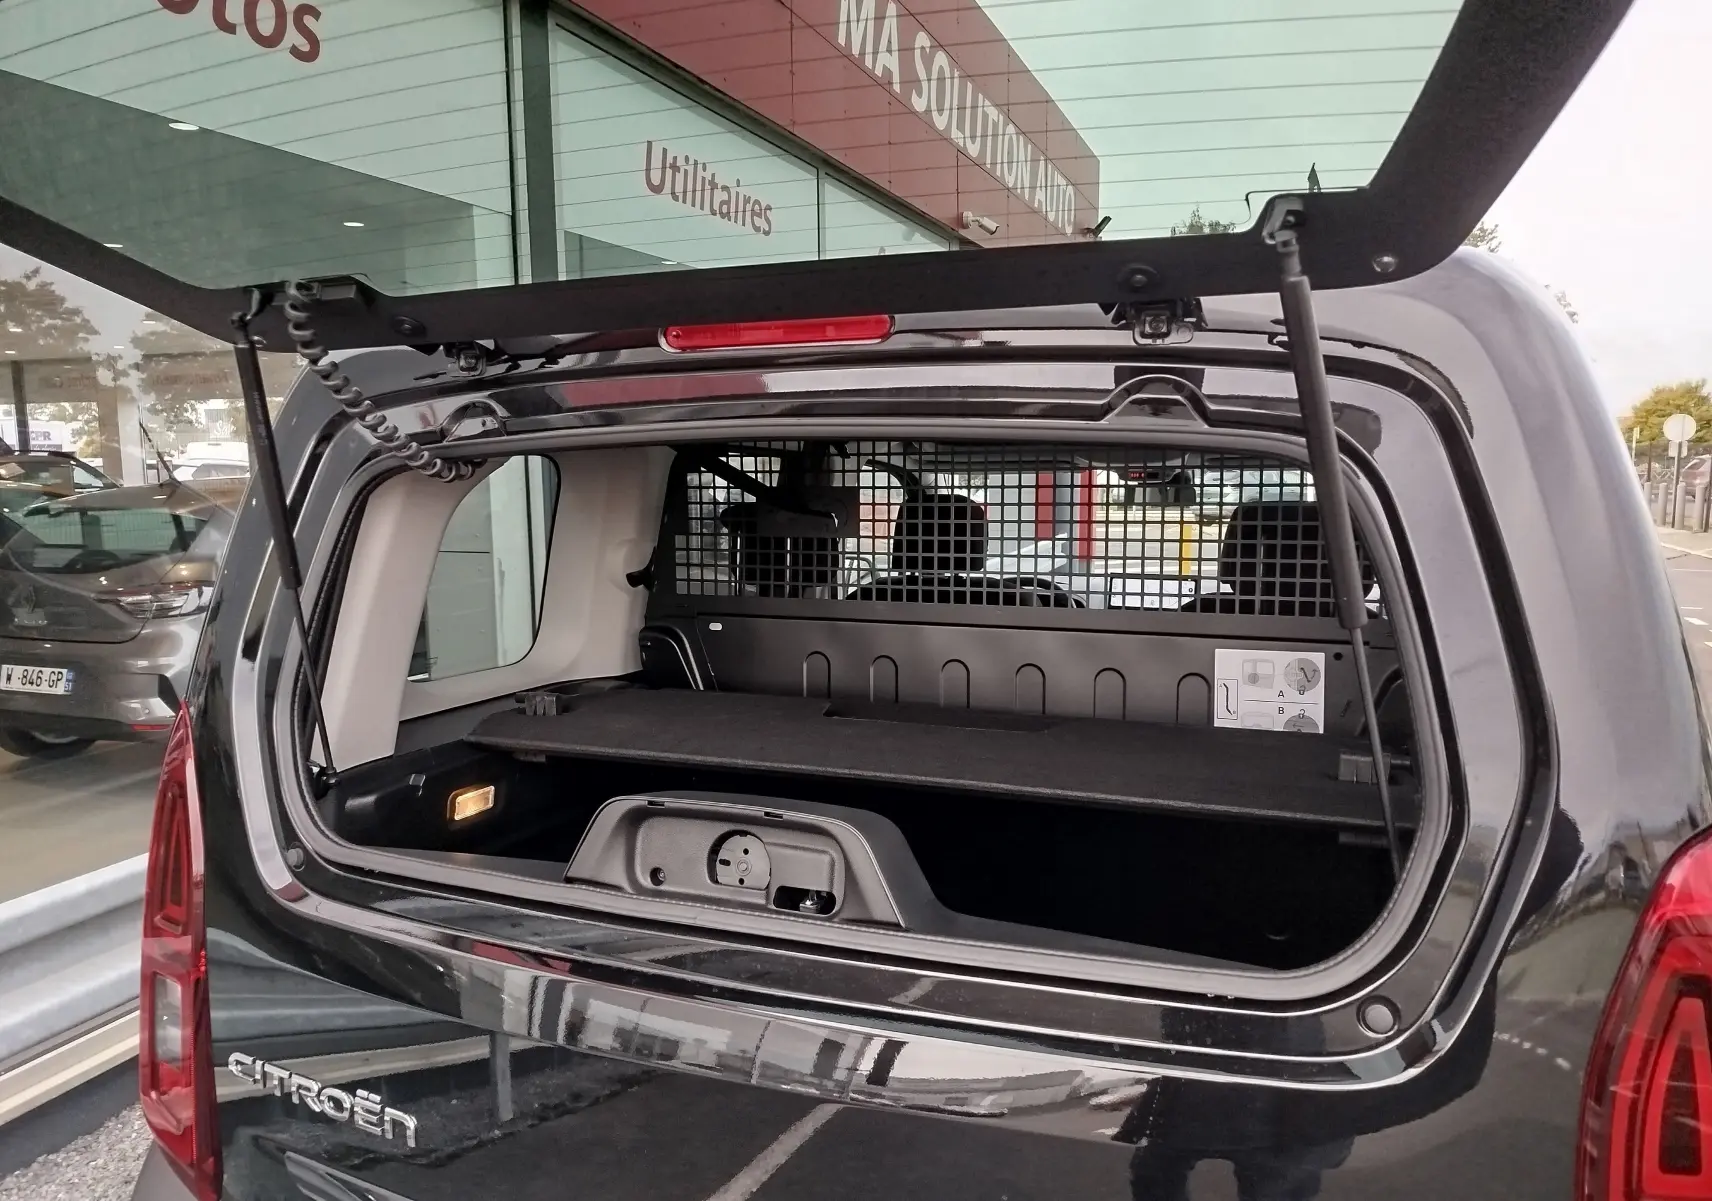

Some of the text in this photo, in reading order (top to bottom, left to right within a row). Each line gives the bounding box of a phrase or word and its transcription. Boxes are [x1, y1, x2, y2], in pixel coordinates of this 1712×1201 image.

[837, 0, 1076, 237] MA SOLUTION AUTO
[645, 140, 773, 236] Utilitaires
[1277, 690, 1285, 698] A
[1278, 706, 1285, 715] B
